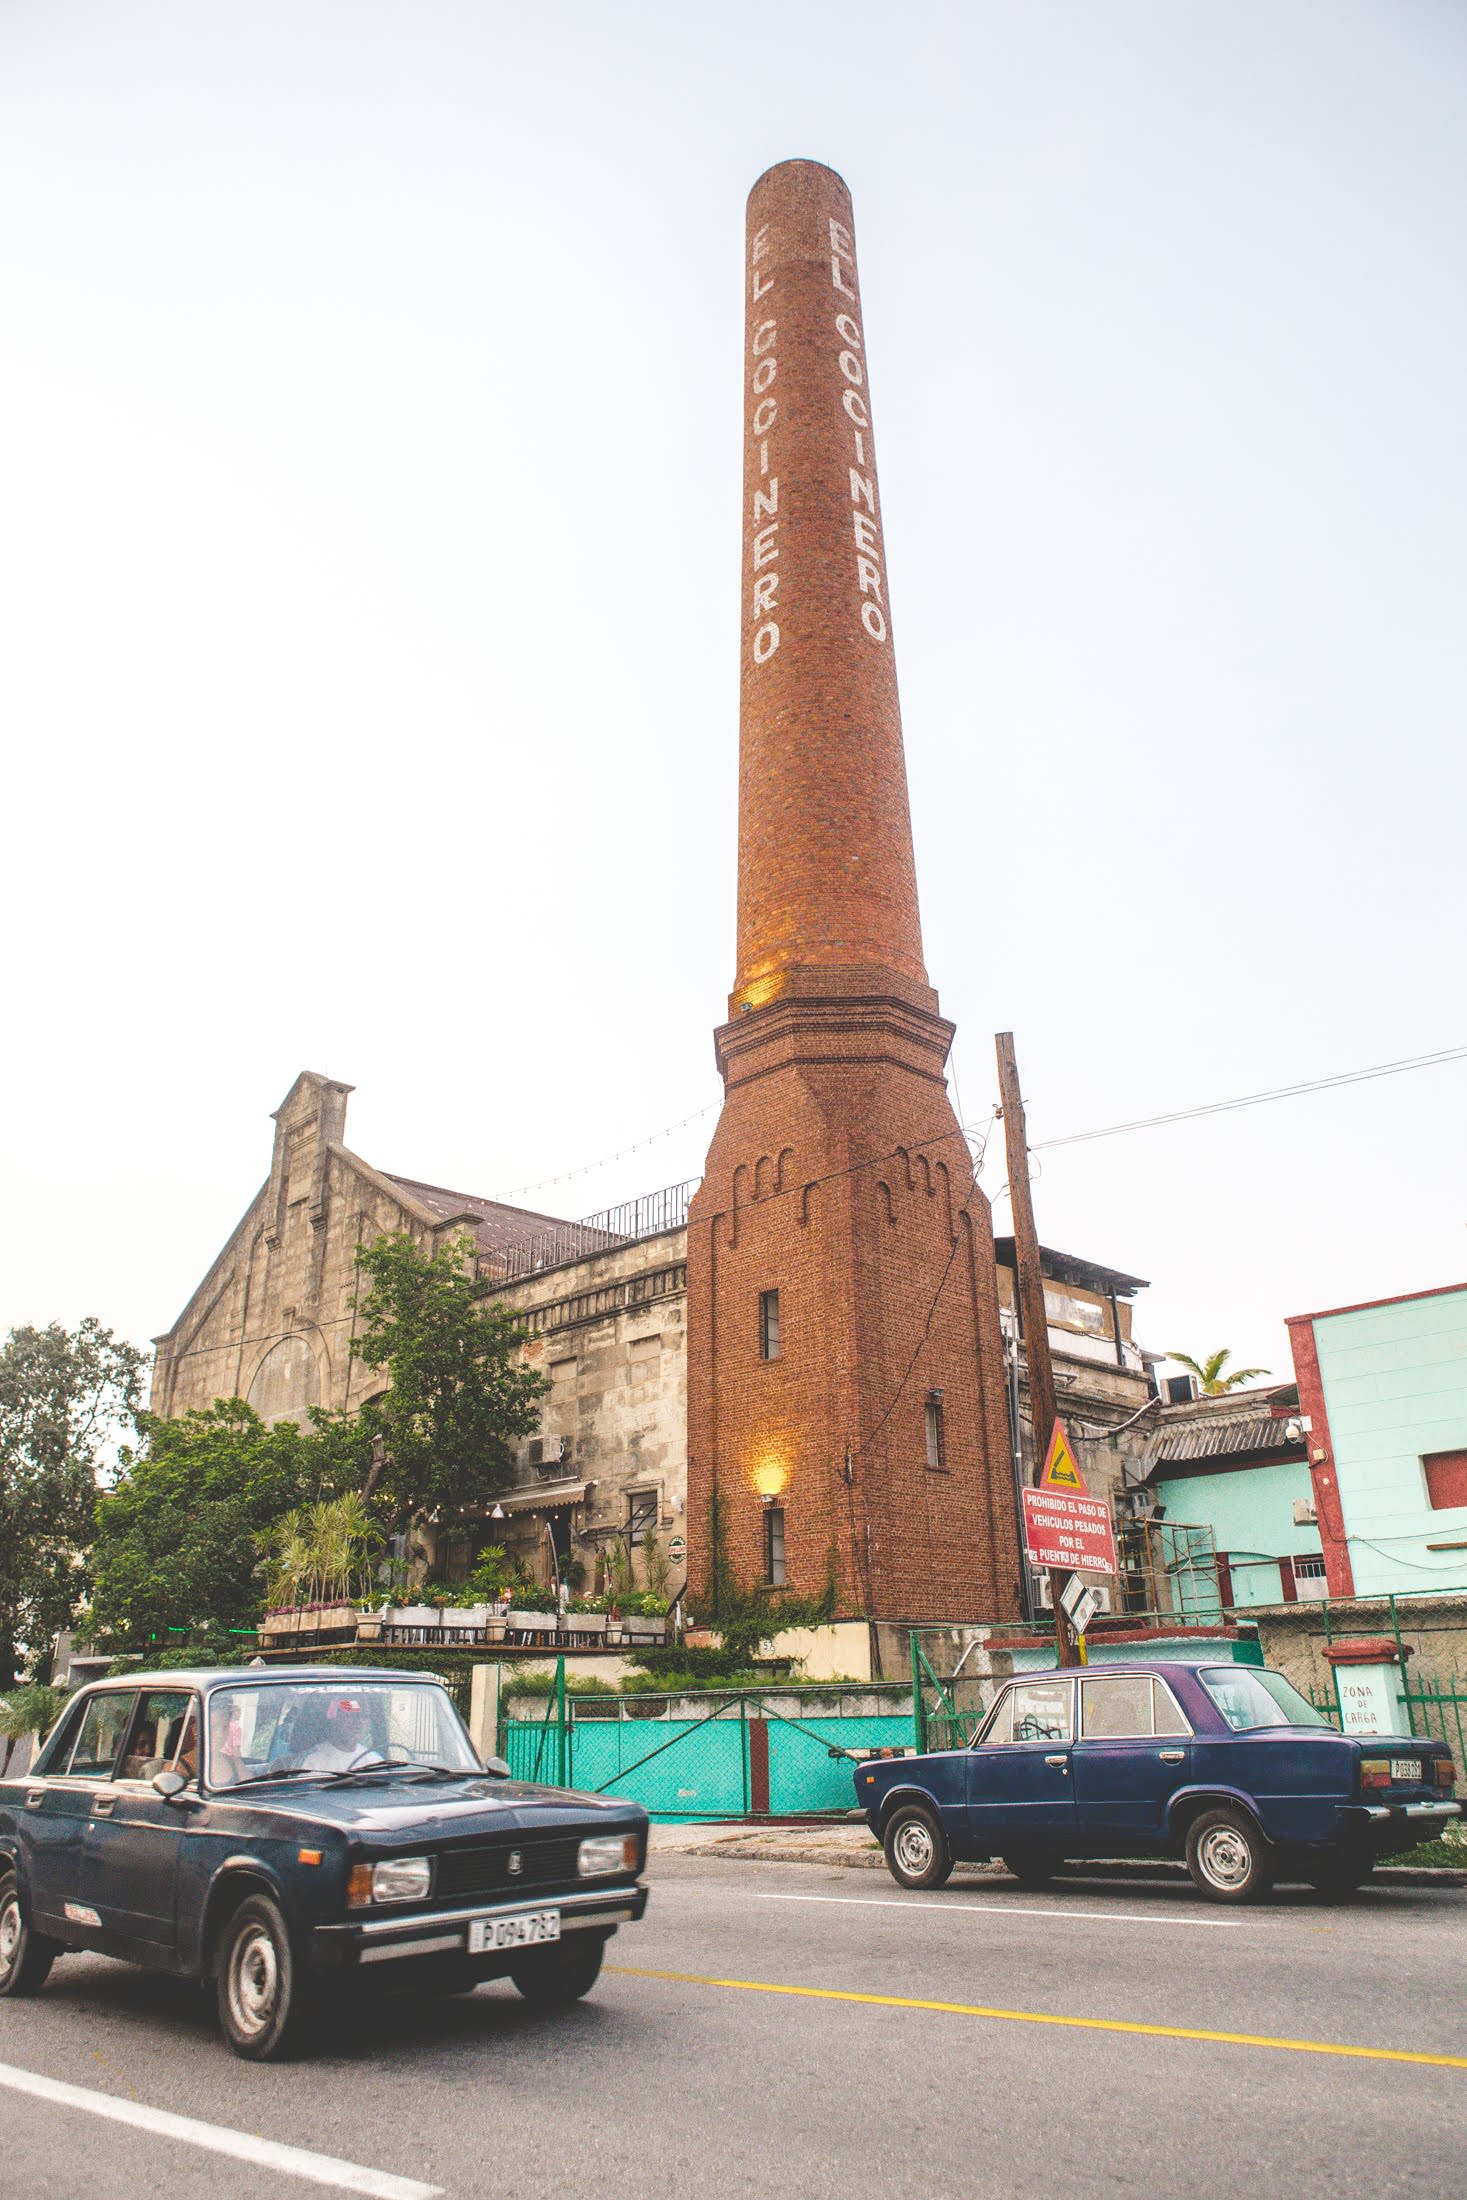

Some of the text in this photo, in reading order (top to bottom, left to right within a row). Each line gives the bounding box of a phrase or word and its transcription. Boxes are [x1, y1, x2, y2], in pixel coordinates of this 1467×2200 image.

[828, 216, 888, 643] EL COCINERO
[752, 223, 780, 665] EL COCINERO
[1026, 1494, 1107, 1519] PROHIBIDO EL PASO DE
[1031, 1513, 1106, 1536] VEHICULOS PESADOS
[1059, 1535, 1085, 1550] POR EL
[1039, 1548, 1069, 1563] PUENT
[1070, 1553, 1081, 1565] DE
[1081, 1554, 1107, 1569] HIERRO
[1343, 1686, 1373, 1698] ZONA
[1357, 1699, 1368, 1709] DE
[1345, 1711, 1377, 1724] CARGA
